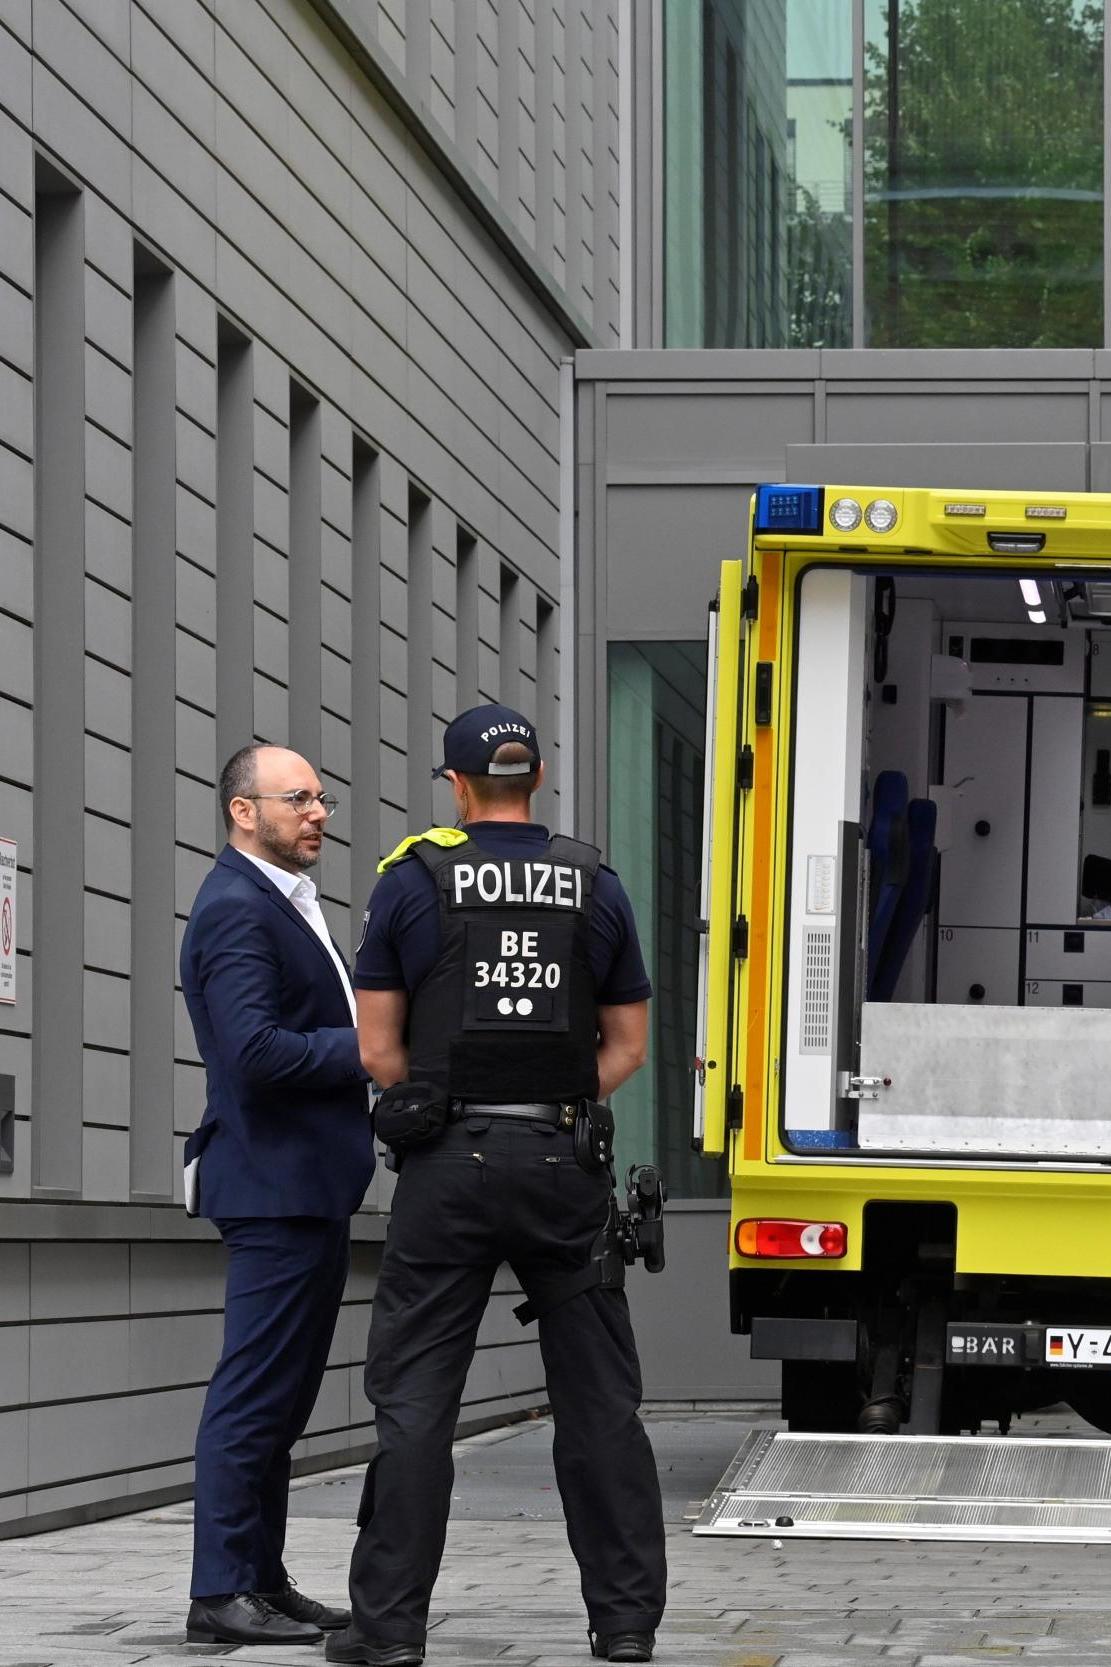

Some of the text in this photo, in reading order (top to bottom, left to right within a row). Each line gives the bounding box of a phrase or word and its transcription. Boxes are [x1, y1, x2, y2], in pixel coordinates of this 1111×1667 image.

[480, 723, 531, 743] POLIZEI
[454, 862, 582, 908] POLIZEI
[501, 930, 538, 957] BE
[941, 929, 953, 942] 10
[1029, 931, 1039, 943] 11
[474, 961, 561, 989] 34320
[1027, 982, 1039, 994] 12
[966, 1336, 1015, 1355] BÄR
